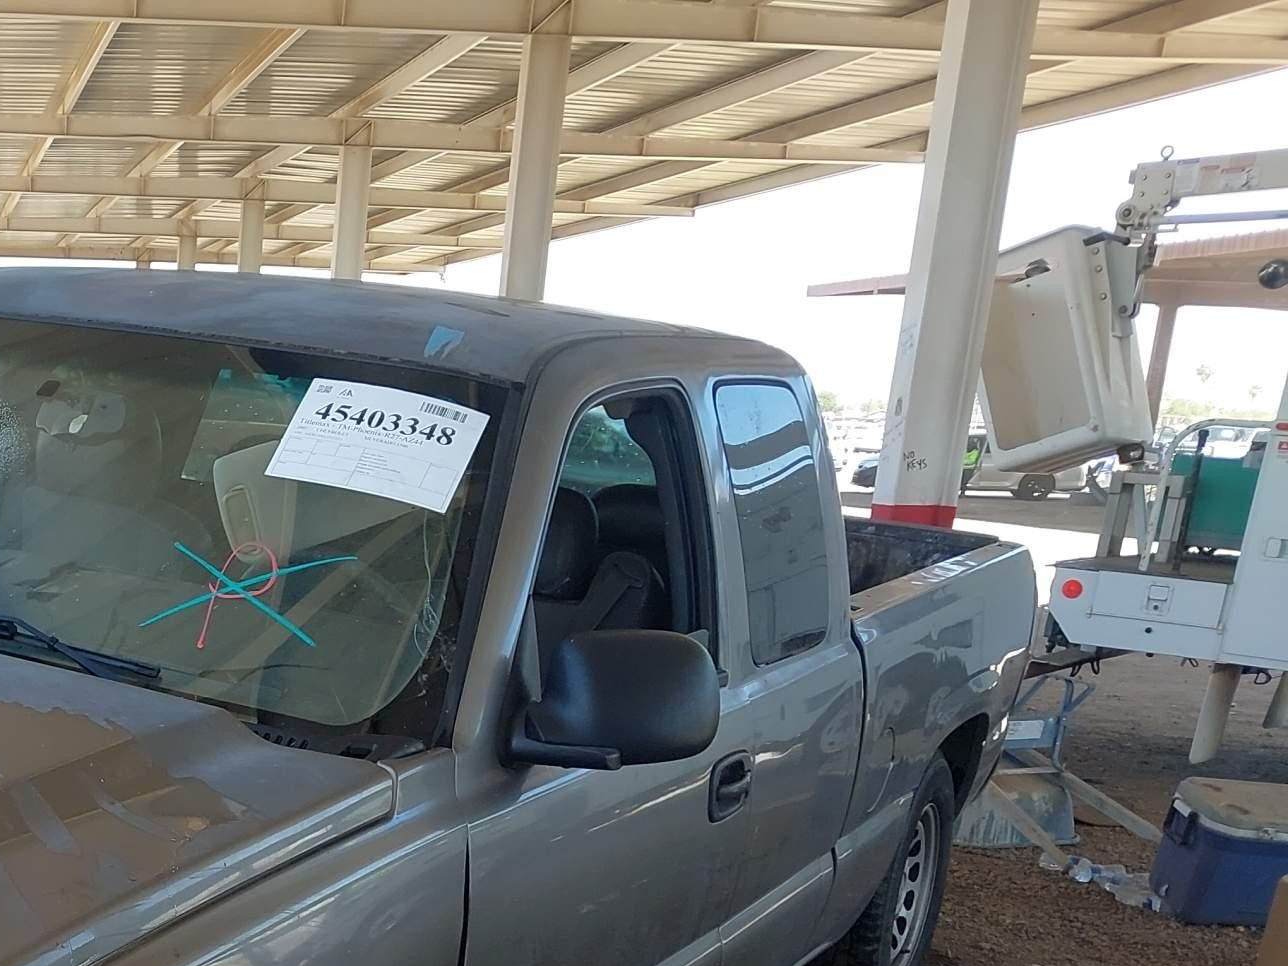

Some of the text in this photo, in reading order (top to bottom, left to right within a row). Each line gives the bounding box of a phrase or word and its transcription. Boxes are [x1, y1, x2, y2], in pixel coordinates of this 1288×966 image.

[315, 402, 457, 446] 45403348
[903, 450, 915, 461] NO
[906, 458, 928, 472] KEYS
